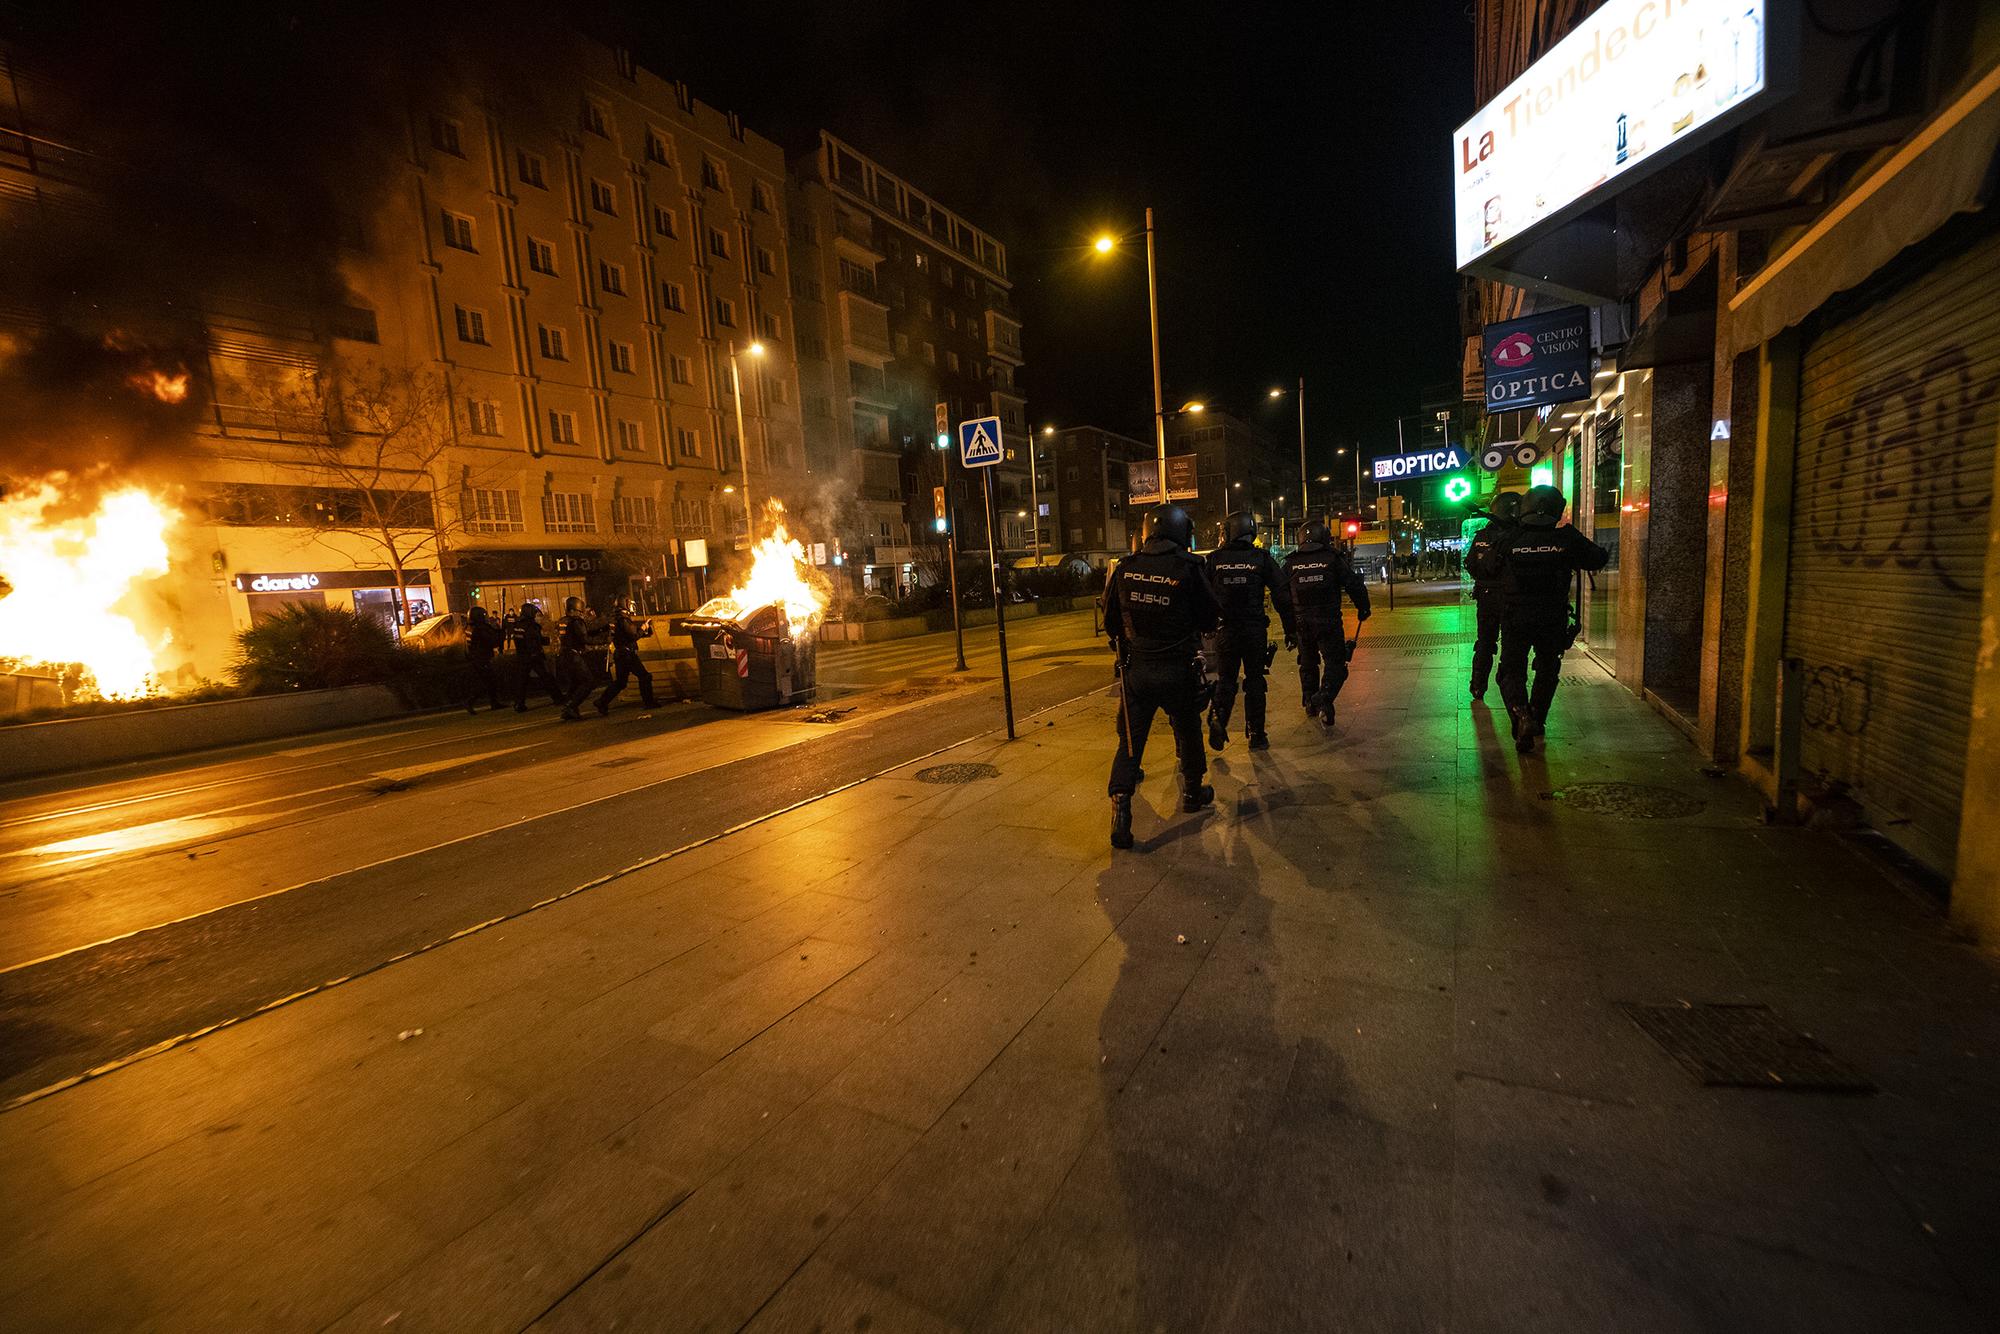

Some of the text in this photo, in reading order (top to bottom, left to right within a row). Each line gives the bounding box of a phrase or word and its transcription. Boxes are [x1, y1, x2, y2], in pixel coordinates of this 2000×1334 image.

[1463, 130, 1495, 174] La
[1536, 326, 1583, 343] CENTRO
[1541, 338, 1580, 355] VISIÓN
[1491, 371, 1585, 400] ÓPTICA
[1393, 451, 1460, 475] OPTICA
[1512, 546, 1558, 554] POLICIA
[1216, 563, 1252, 571] POLICIA
[1292, 563, 1324, 571] POLICIA
[251, 574, 312, 592] clarel
[1124, 572, 1171, 586] POLICIA
[1130, 591, 1170, 606] SUS40
